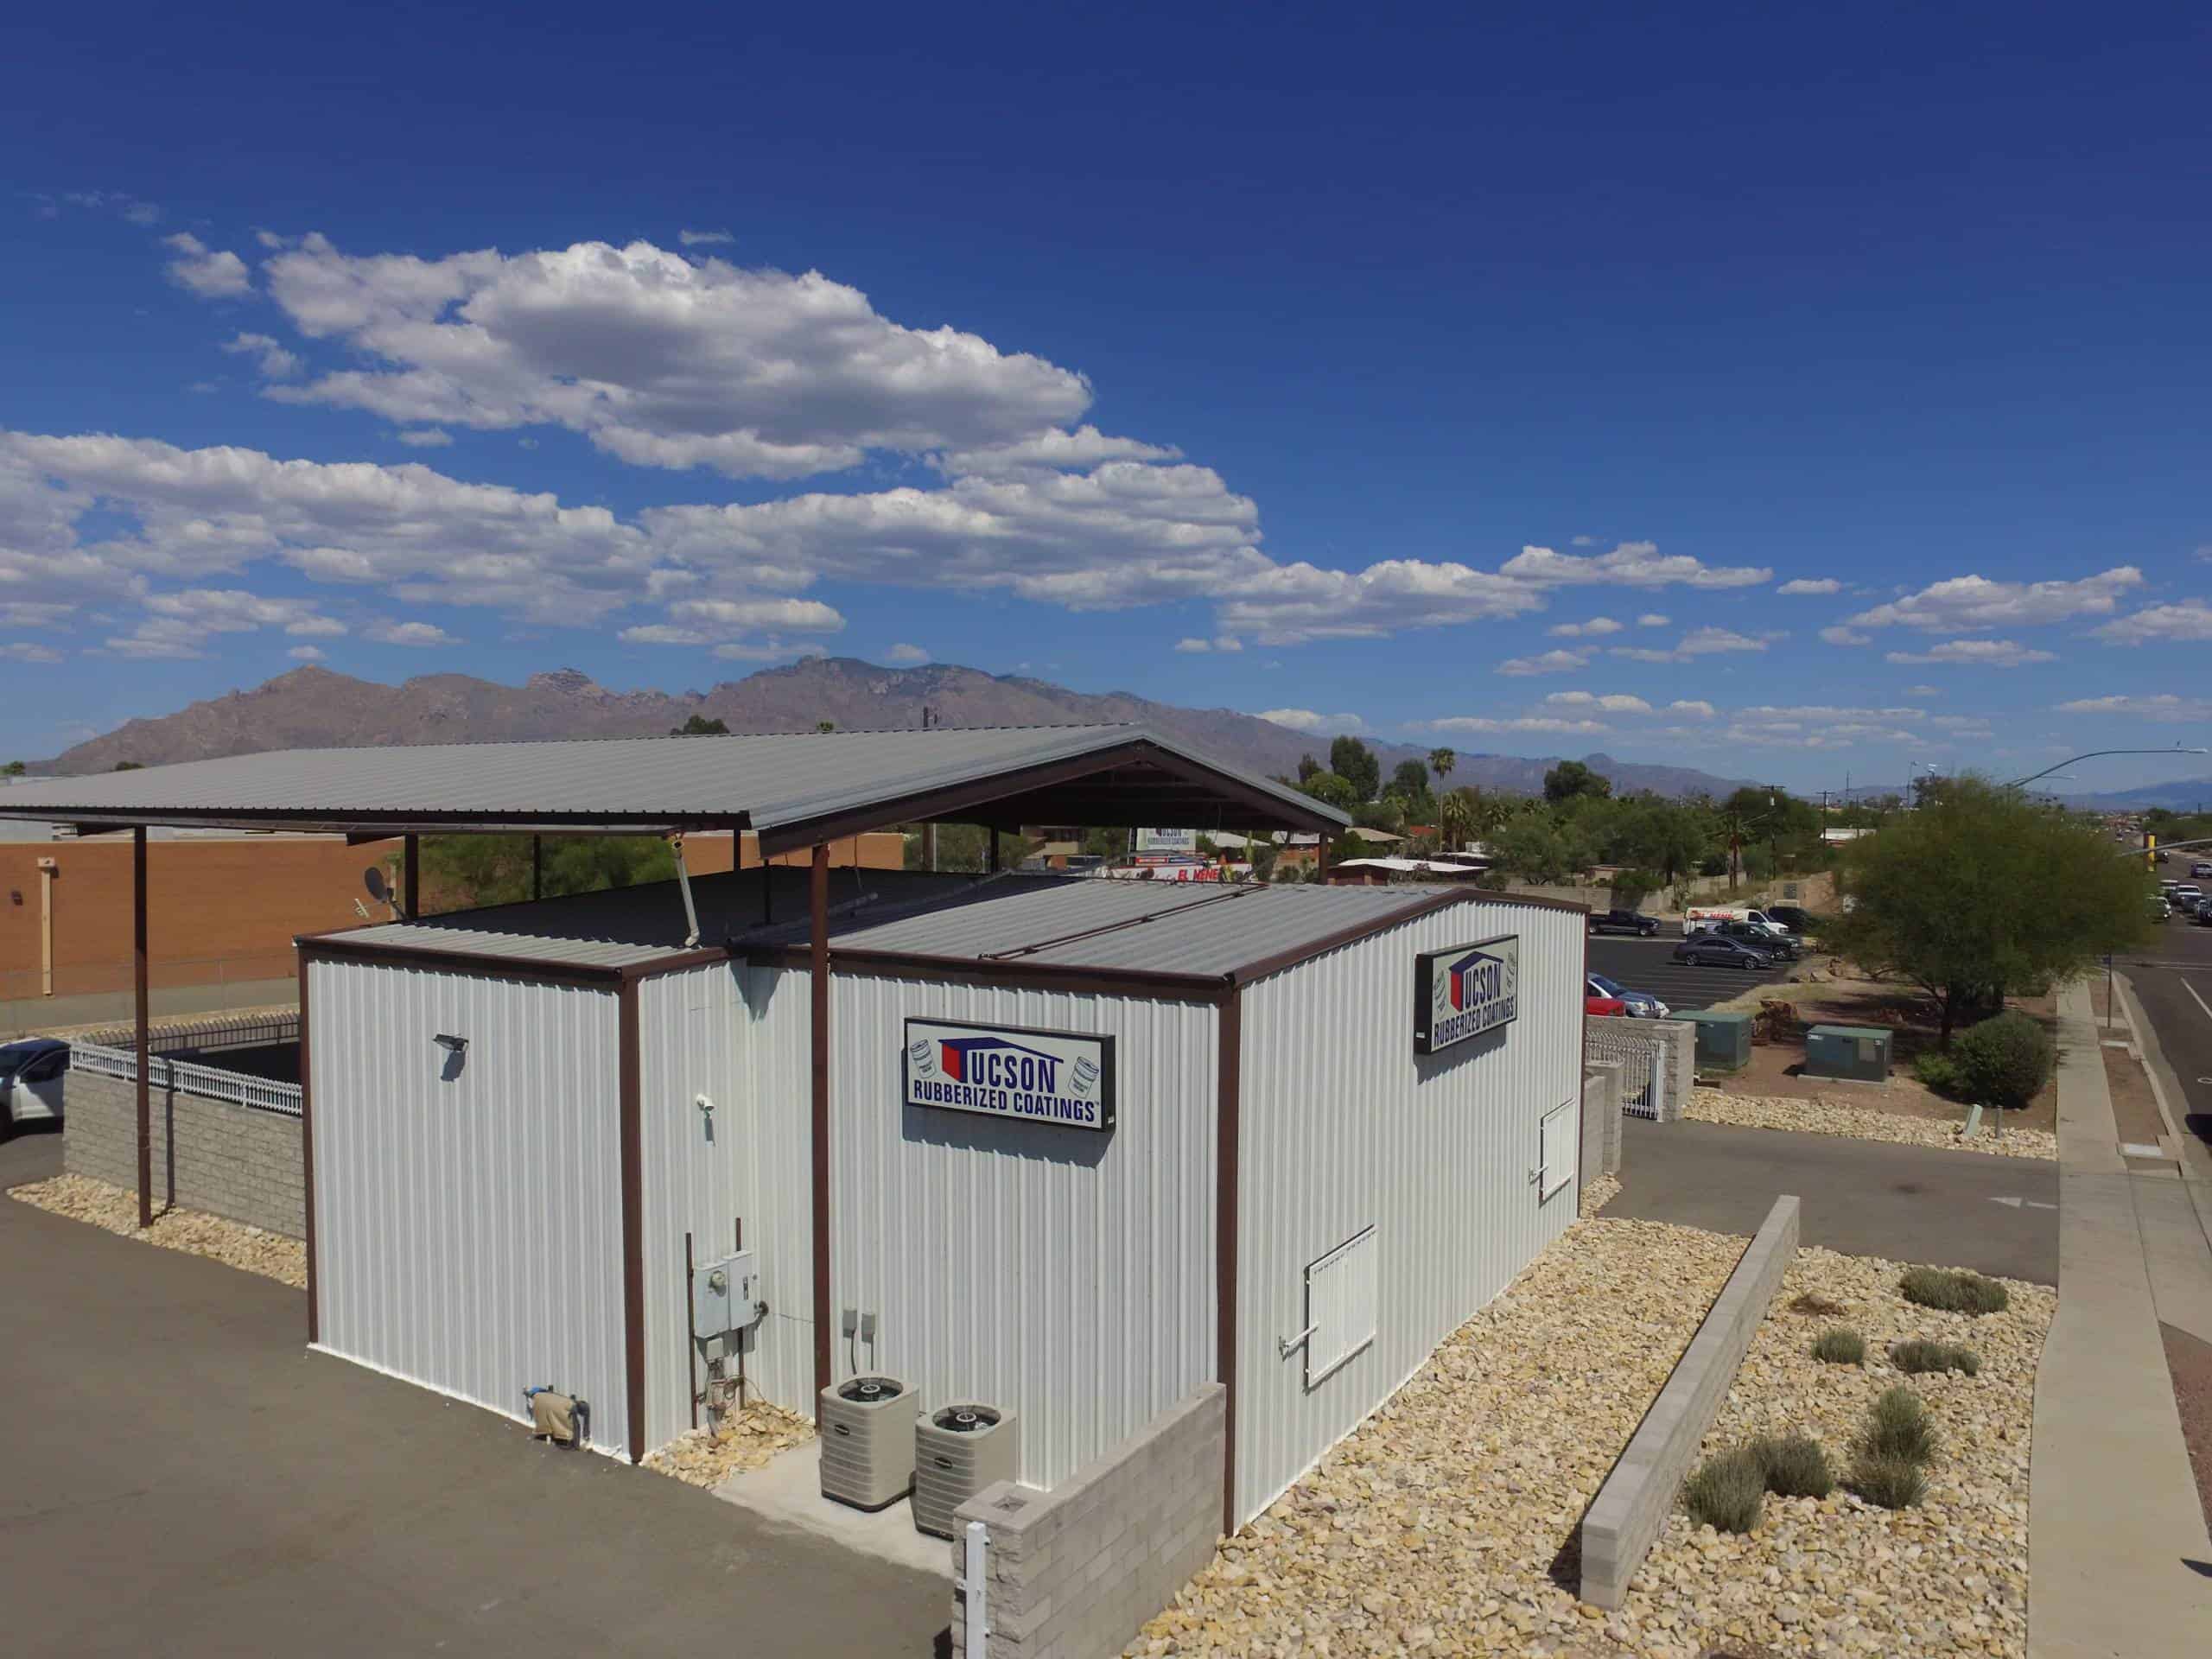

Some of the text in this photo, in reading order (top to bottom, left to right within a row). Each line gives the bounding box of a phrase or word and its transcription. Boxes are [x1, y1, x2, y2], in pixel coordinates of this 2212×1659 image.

[1433, 995, 1514, 1046] RUBBERIZED COATINGS
[914, 1079, 1095, 1122] RUBBERIZED COATINGS
